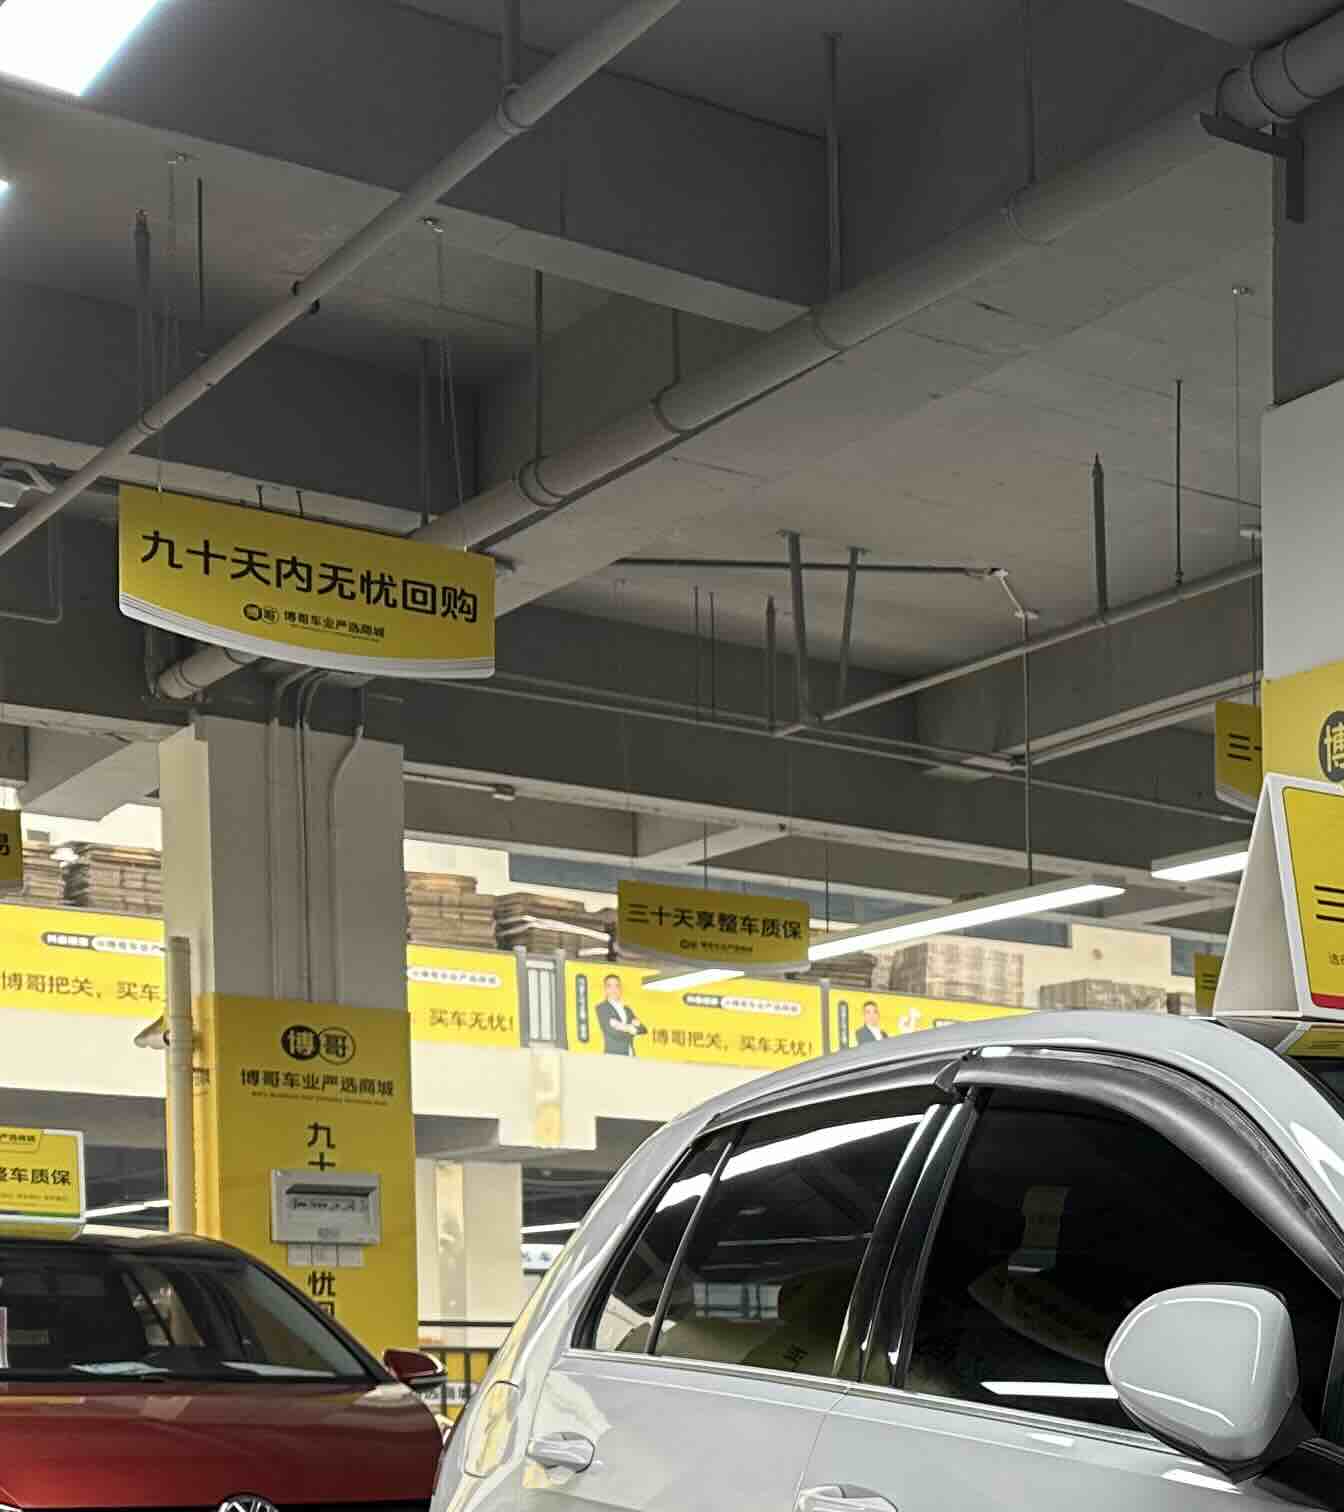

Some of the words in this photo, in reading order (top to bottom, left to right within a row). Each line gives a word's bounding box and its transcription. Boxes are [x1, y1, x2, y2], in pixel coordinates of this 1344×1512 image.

[141, 530, 478, 624] 九十天内无忧回购
[626, 903, 803, 940] 三十天享整车质保
[285, 1028, 352, 1061] 博哥
[241, 1068, 394, 1097] 博哥车业严选商城
